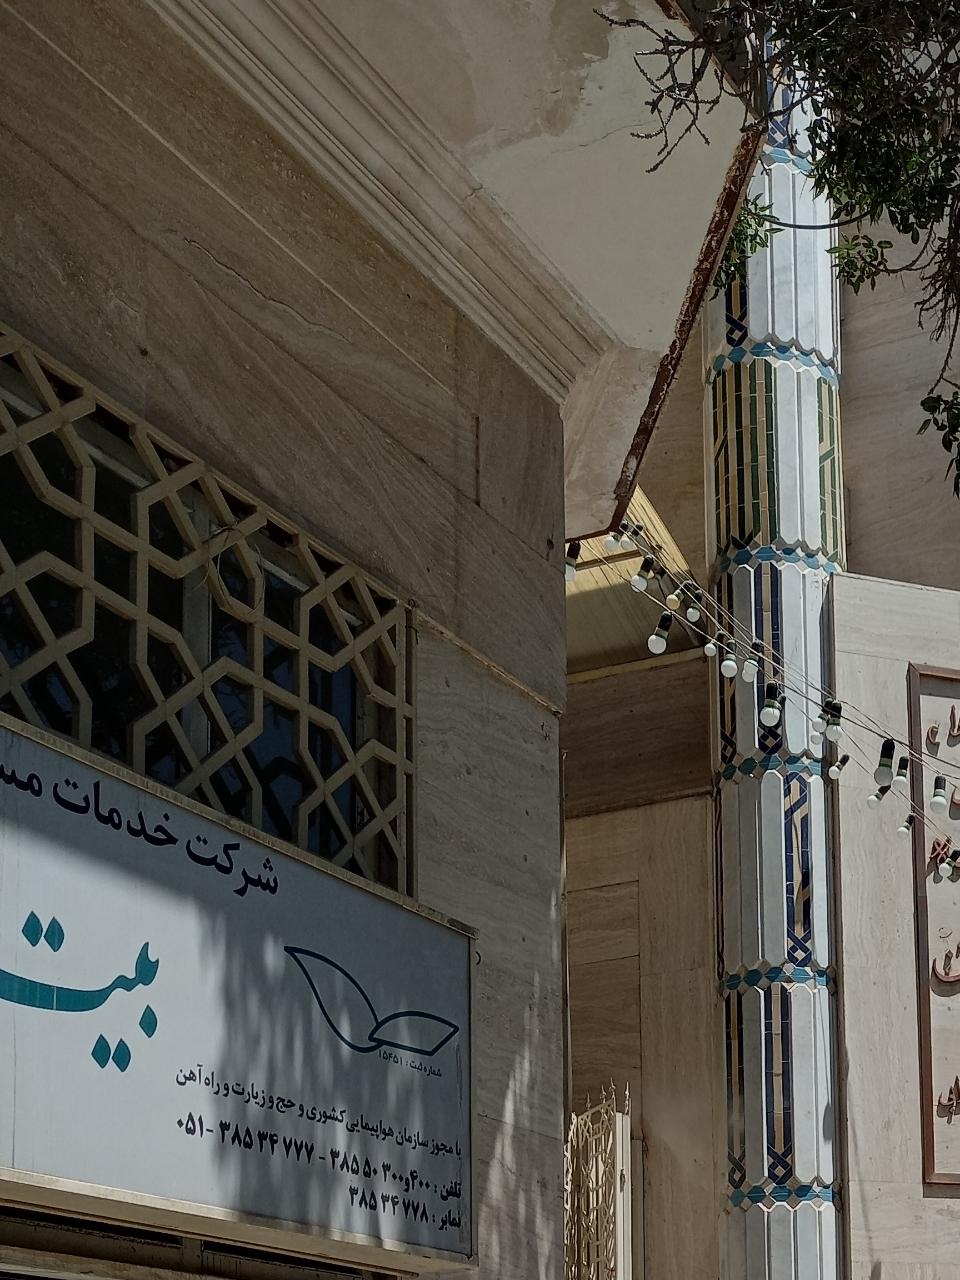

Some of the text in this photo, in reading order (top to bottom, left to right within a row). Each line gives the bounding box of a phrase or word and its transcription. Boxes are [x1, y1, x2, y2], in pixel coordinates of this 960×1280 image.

[53, 780, 179, 846] خدمات
[185, 834, 279, 897] شرکت
[410, 1060, 422, 1072] ثبت
[424, 1065, 442, 1077] شماره
[176, 1064, 462, 1161] با مجوز سازمان هواپیمایی کشوری و حج و زیارت و راه آهن
